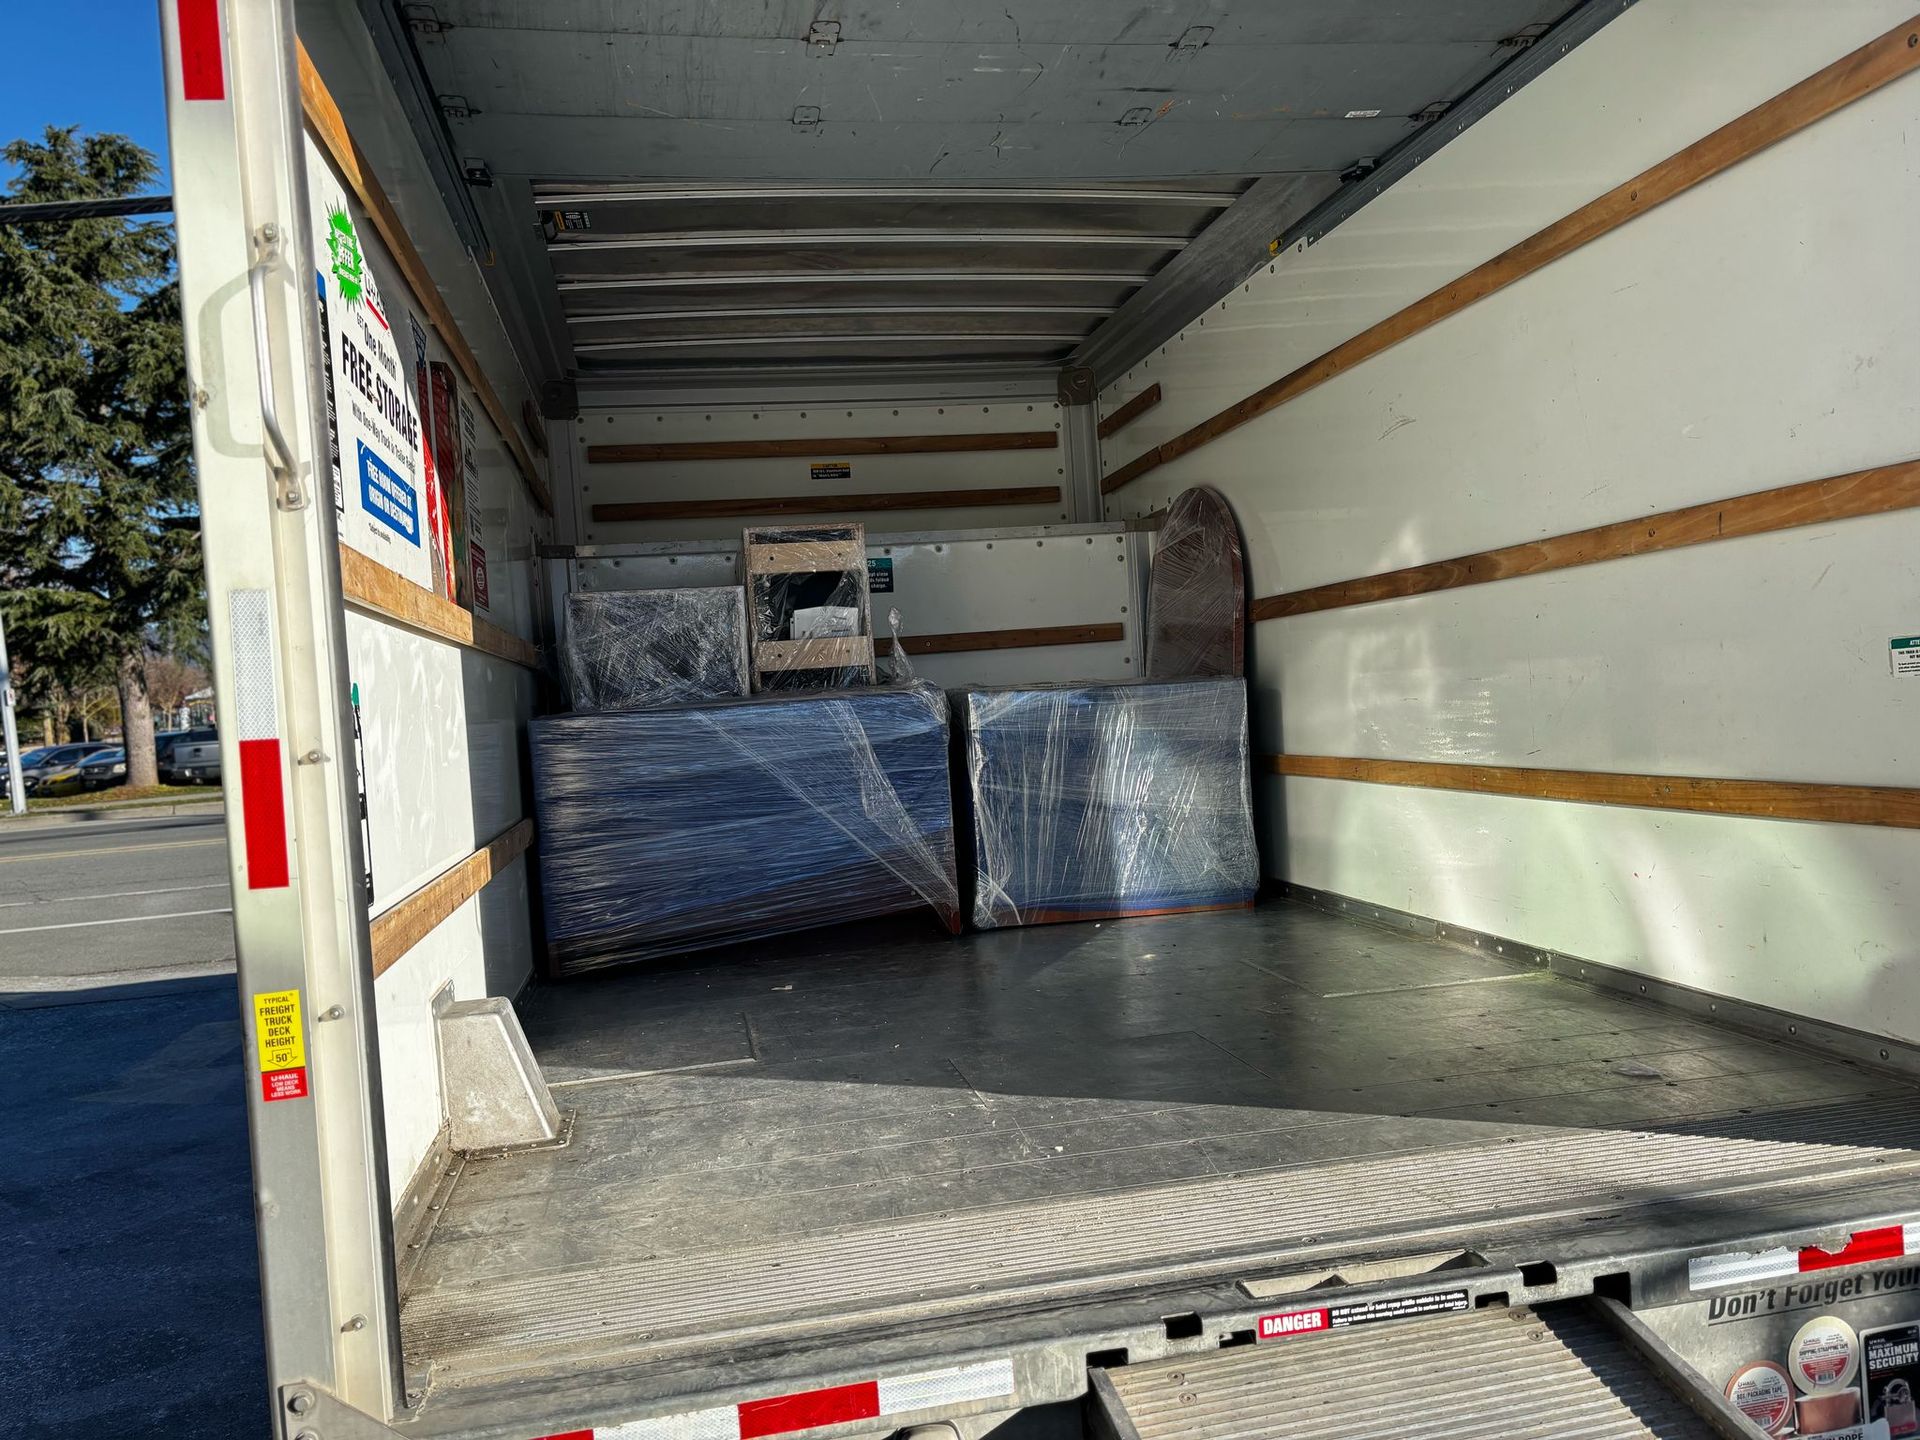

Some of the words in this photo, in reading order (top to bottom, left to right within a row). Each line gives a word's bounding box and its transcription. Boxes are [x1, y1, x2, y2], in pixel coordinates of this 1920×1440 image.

[364, 322, 377, 356] One
[342, 331, 373, 403] FREE
[376, 373, 418, 452] STORAGE
[264, 996, 290, 1004] TYPICAL
[259, 1004, 295, 1016] FREIGHT
[264, 1015, 293, 1026] TRUCK
[268, 1026, 291, 1037] DECK
[265, 1036, 296, 1048] HEIGHT
[1708, 1289, 1776, 1321] Don't
[1784, 1274, 1864, 1307] Forget
[1263, 1312, 1322, 1336] DANGER
[1868, 1342, 1919, 1360] MAXIMUM
[1869, 1352, 1920, 1370] SECURITY
